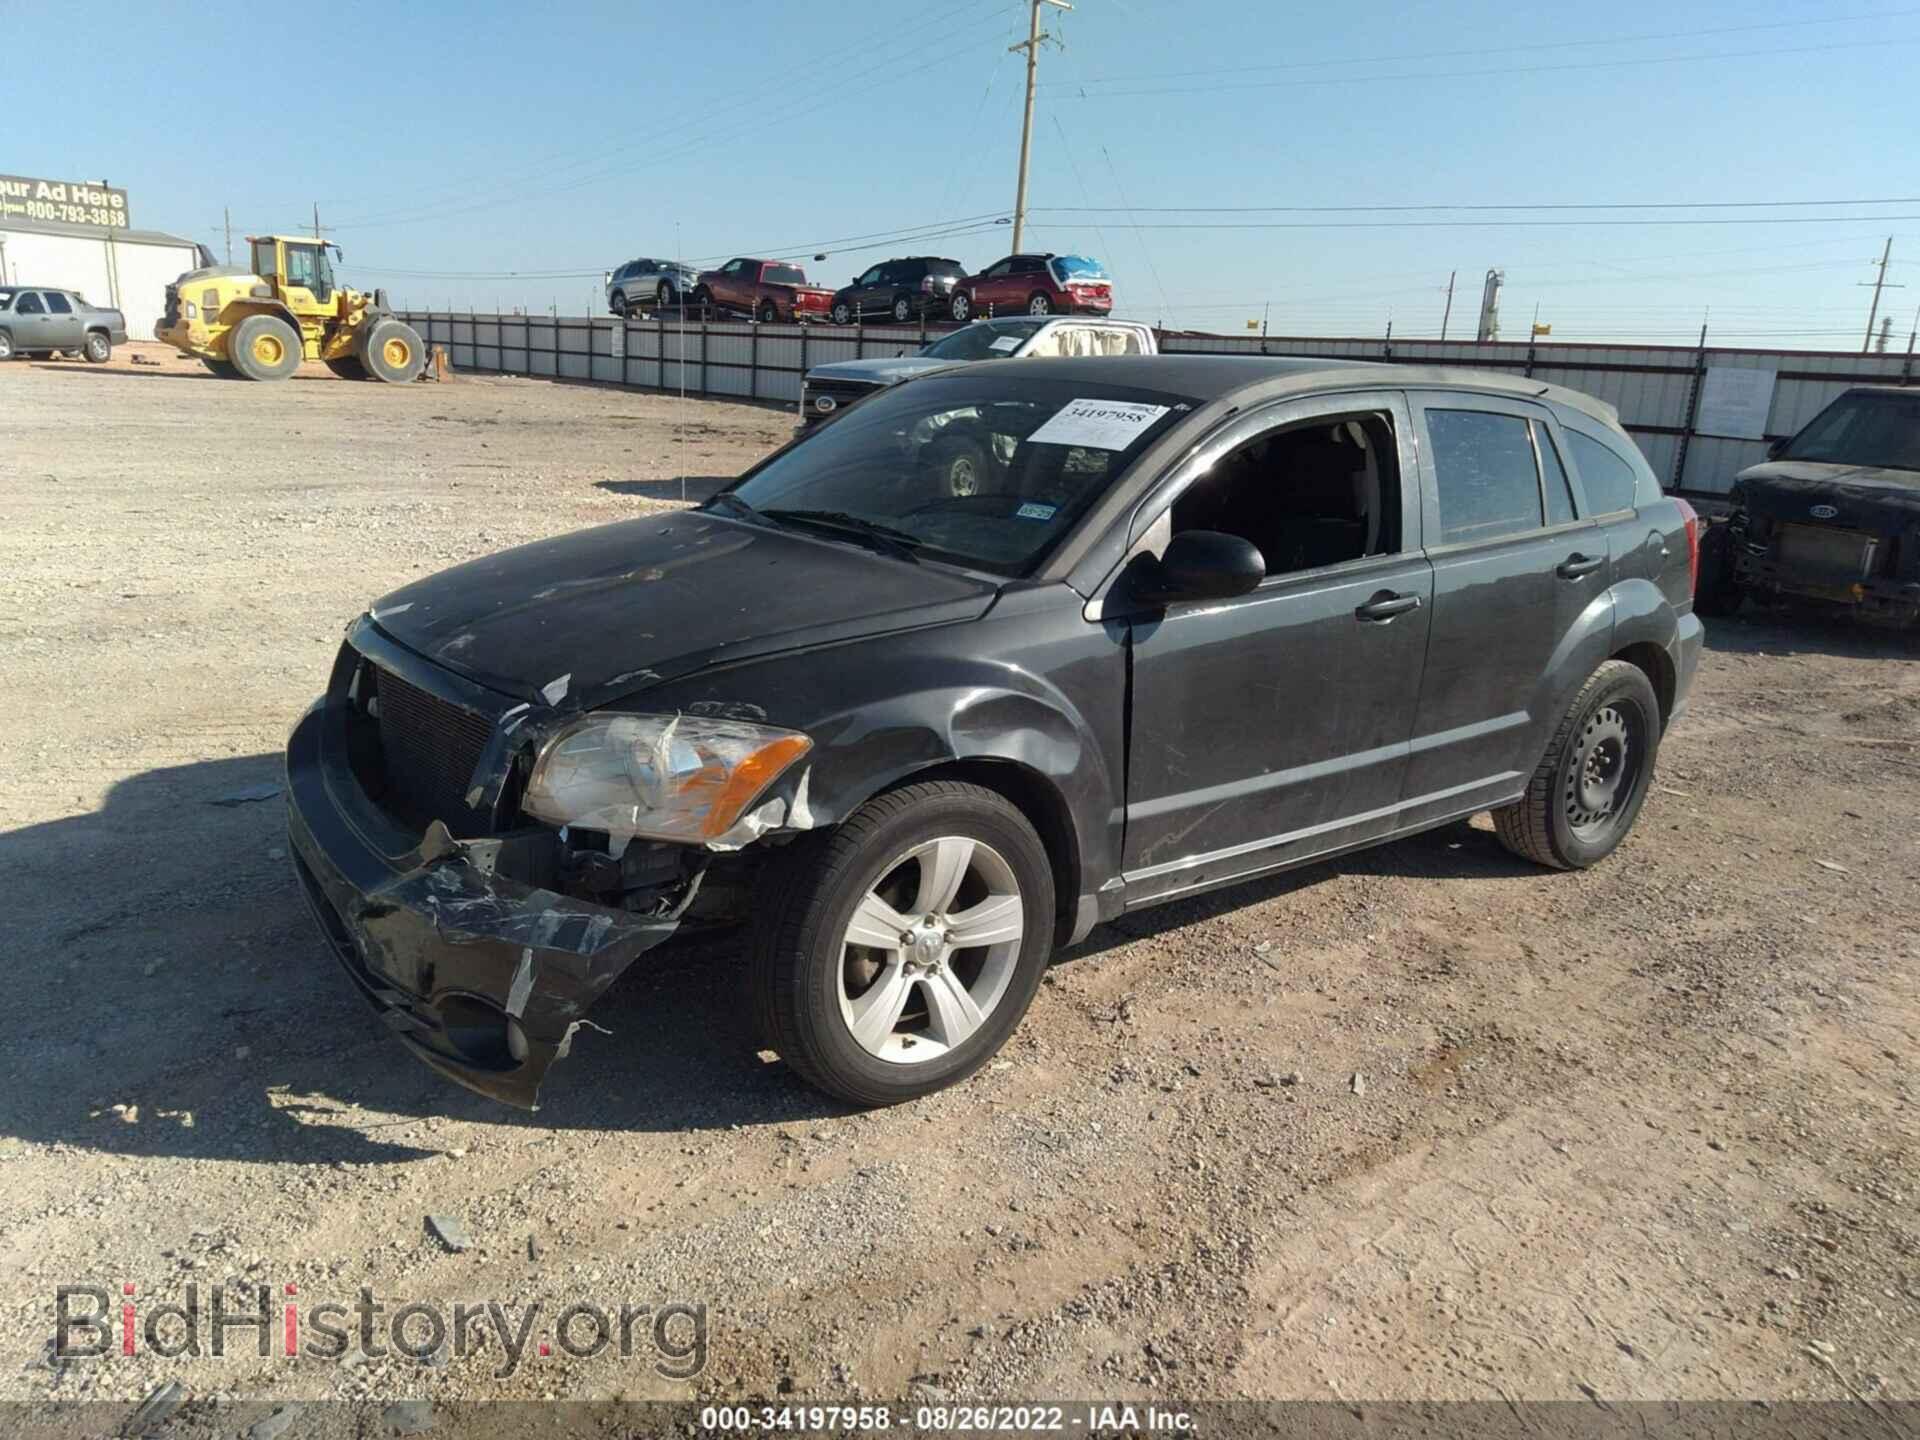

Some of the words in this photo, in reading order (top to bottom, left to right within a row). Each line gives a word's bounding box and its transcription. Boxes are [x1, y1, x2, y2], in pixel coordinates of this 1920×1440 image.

[36, 181, 67, 202] Ad
[72, 185, 124, 208] Here
[1067, 407, 1146, 423] 34197958
